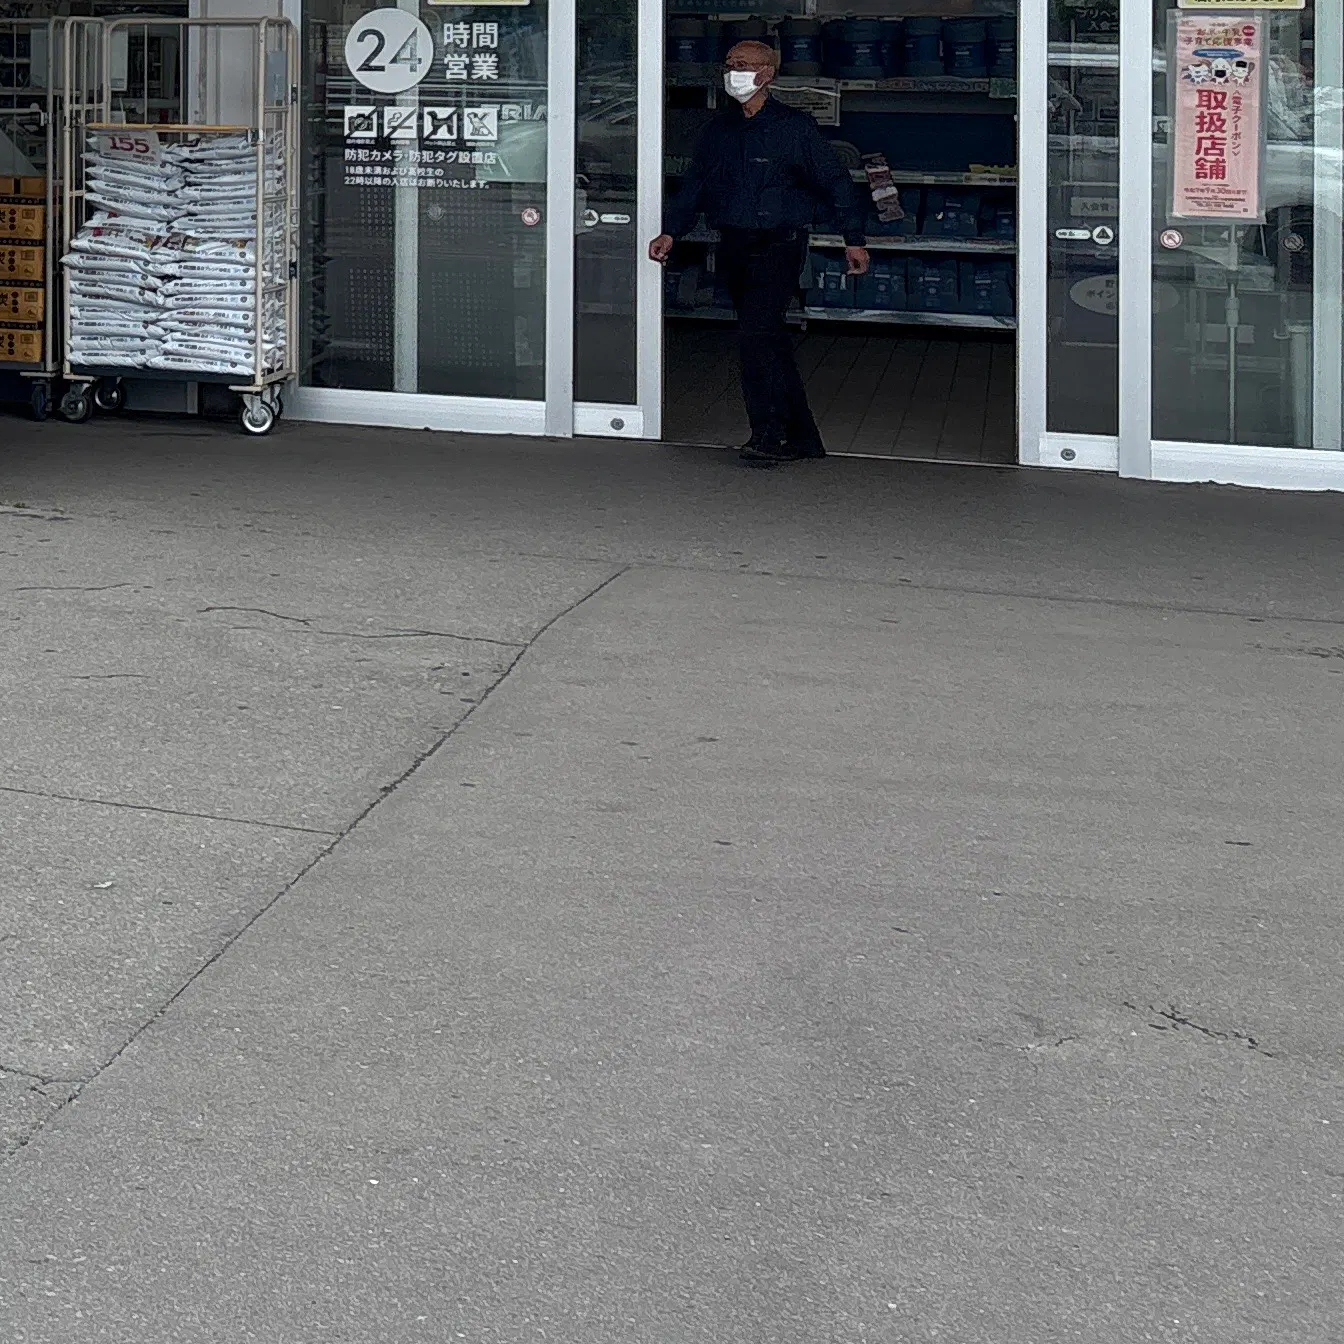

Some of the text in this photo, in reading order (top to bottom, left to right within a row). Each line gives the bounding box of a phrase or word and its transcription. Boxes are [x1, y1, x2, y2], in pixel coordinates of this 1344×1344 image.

[355, 22, 499, 74] 24 時間
[443, 52, 500, 81] 営業
[107, 136, 150, 154] 155
[1195, 88, 1228, 181] 取扱店舗
[344, 148, 497, 165] 防犯カメラ・防犯タグ設置店
